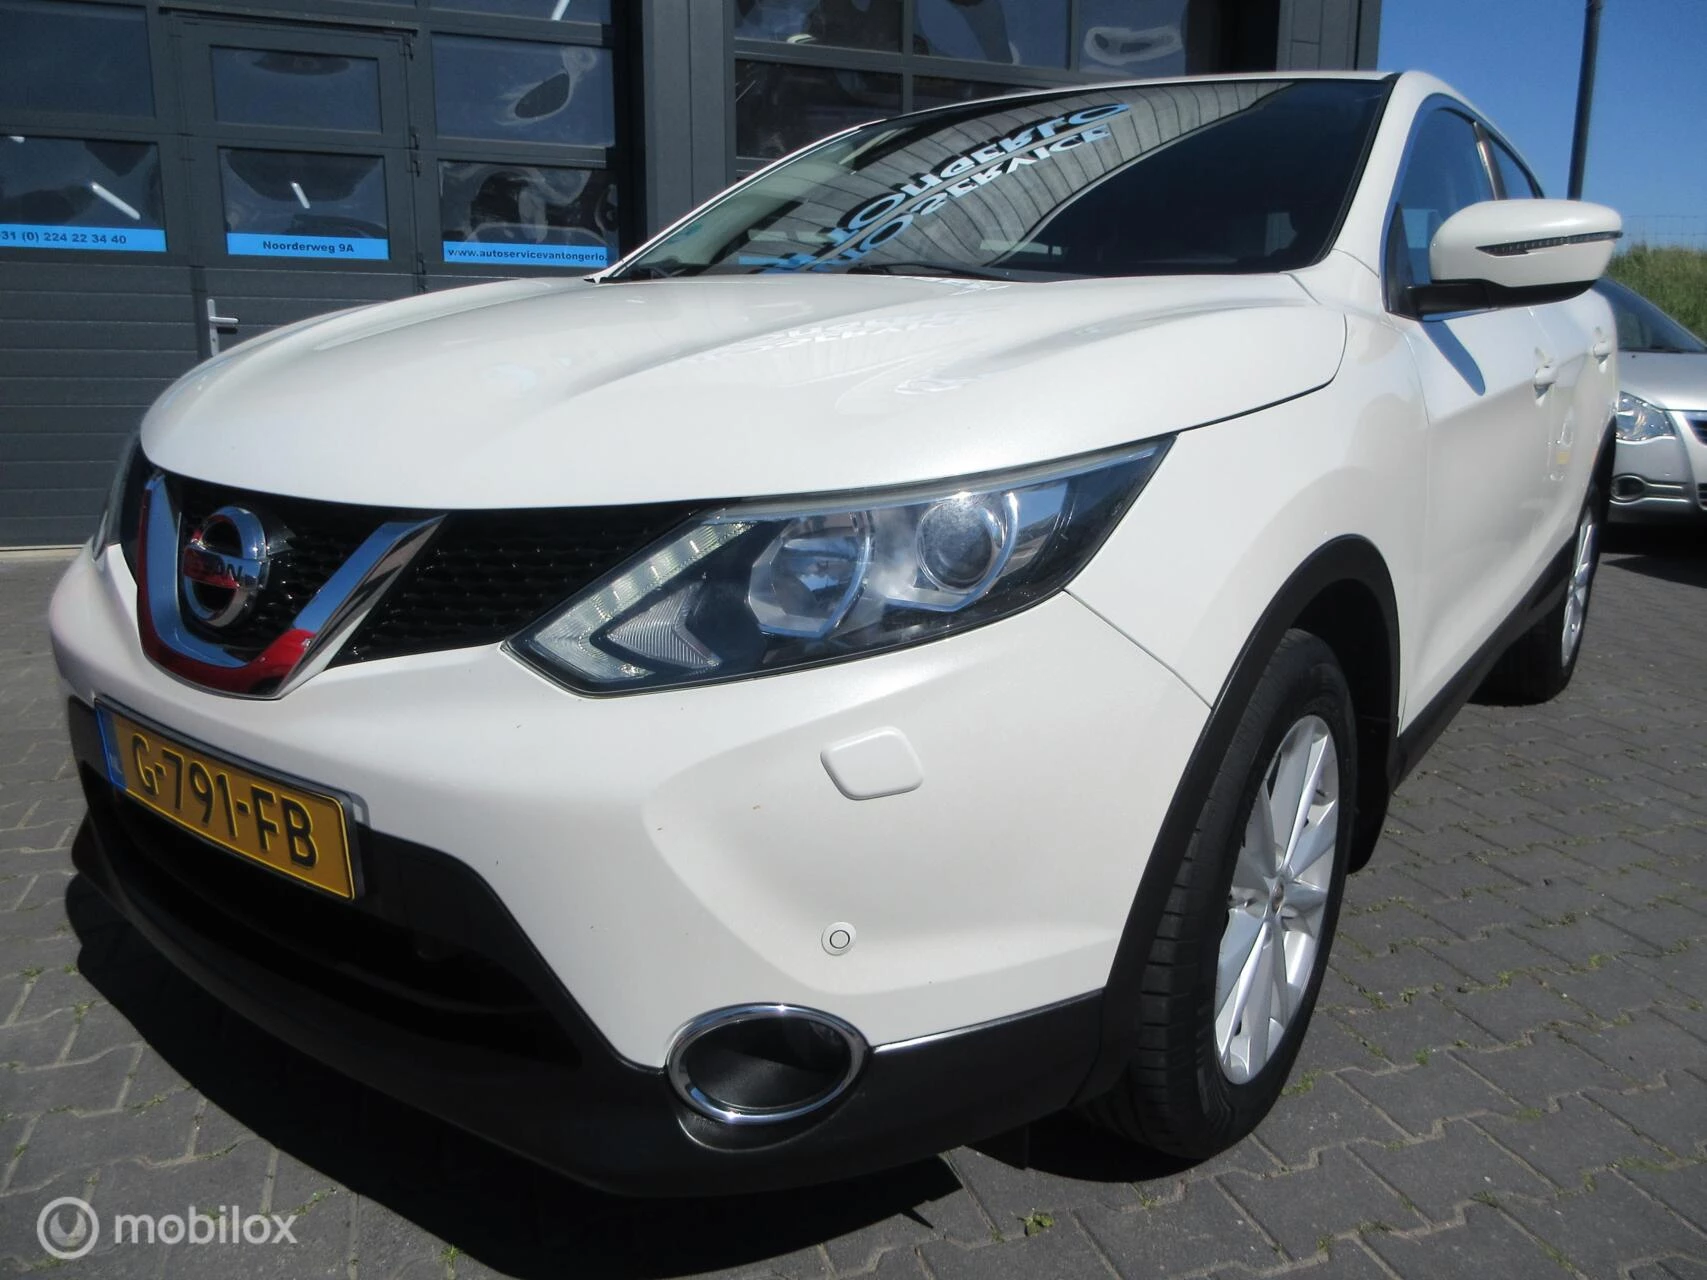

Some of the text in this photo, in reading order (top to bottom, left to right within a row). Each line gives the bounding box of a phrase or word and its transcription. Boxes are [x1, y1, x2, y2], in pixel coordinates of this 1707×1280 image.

[22, 231, 39, 243] (0)
[43, 231, 67, 242] 224
[72, 232, 88, 243] 22
[92, 233, 107, 244] 34
[111, 234, 127, 244] 40
[263, 240, 355, 254] Noorderweg 9A
[131, 732, 319, 869] G-791-FB
